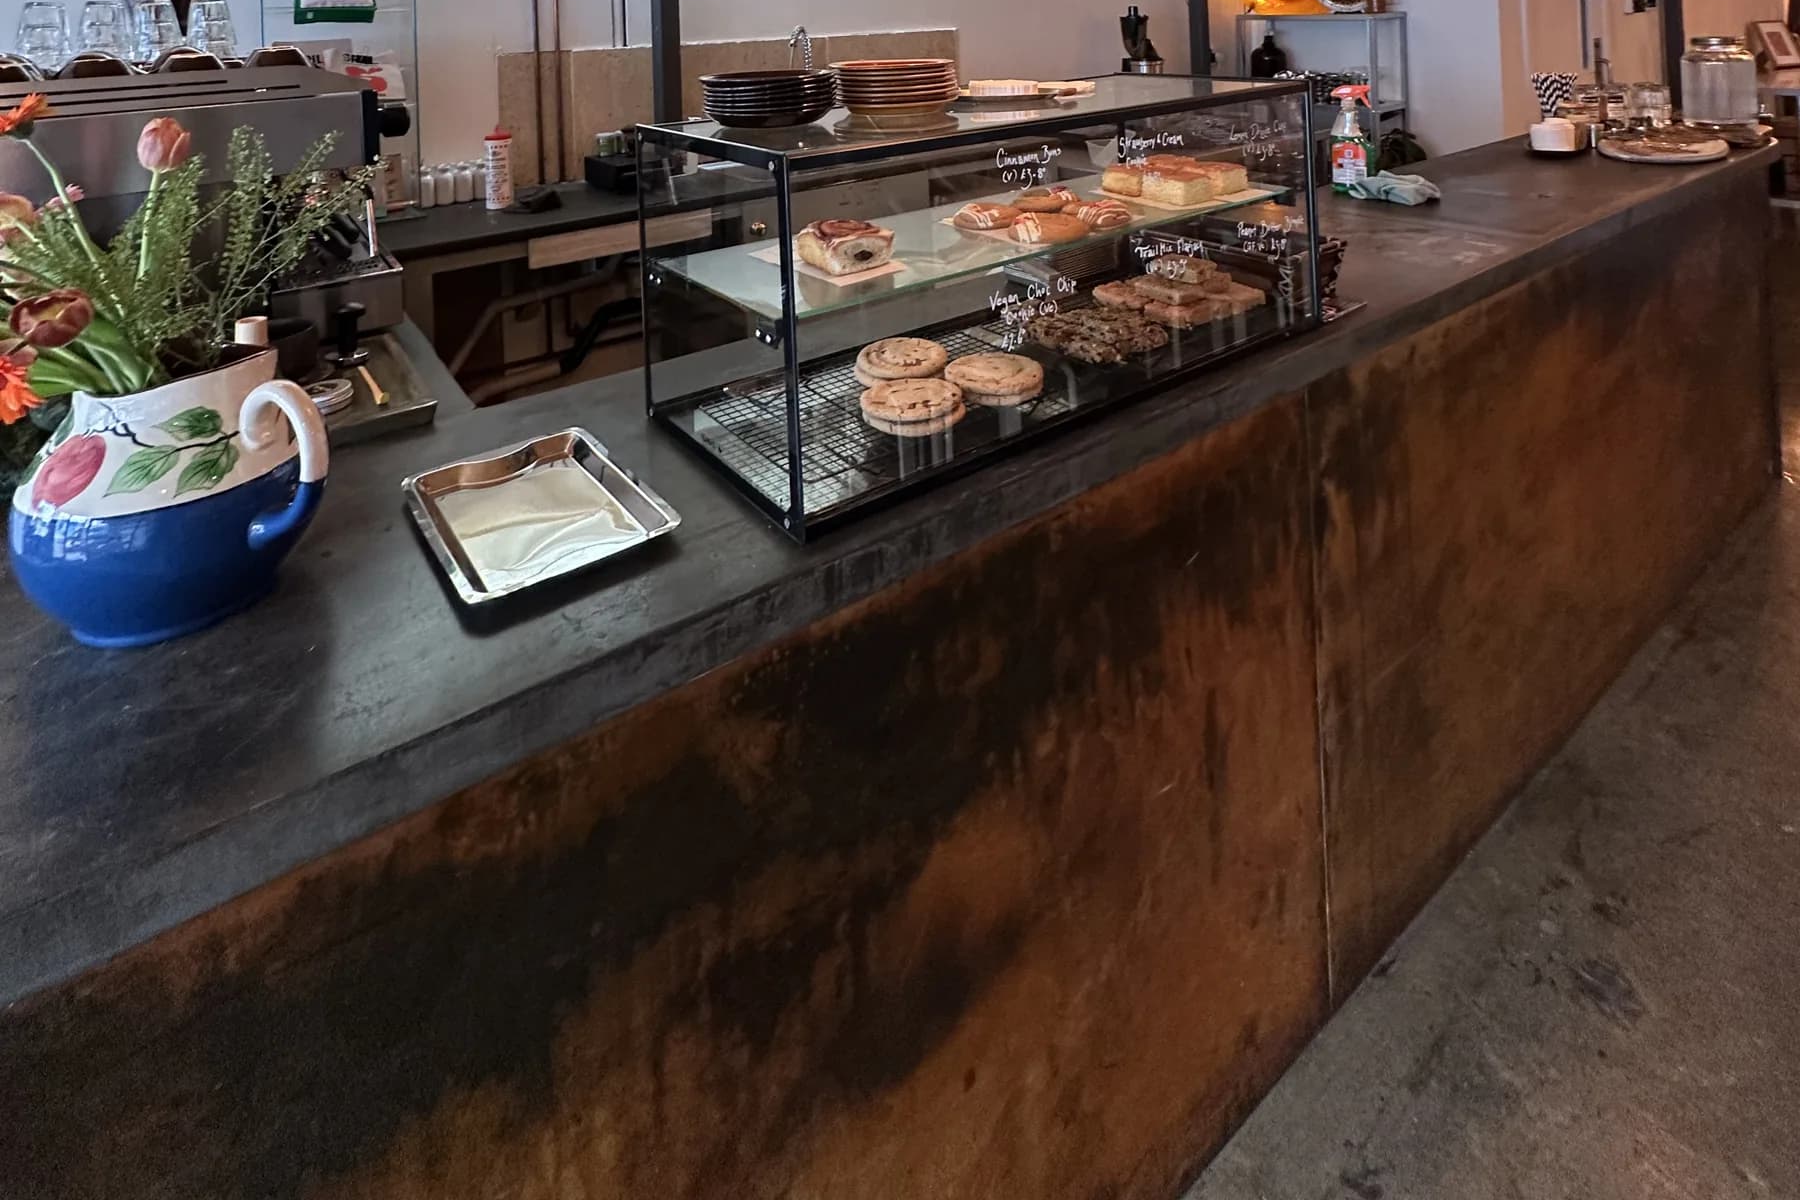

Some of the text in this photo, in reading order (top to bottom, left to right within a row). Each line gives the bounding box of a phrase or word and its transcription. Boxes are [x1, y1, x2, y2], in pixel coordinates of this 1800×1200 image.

[1162, 132, 1184, 146] Cream
[1134, 244, 1159, 258] Trail
[1160, 243, 1173, 256] Mix
[989, 276, 1077, 314] Vegan Choc Chip
